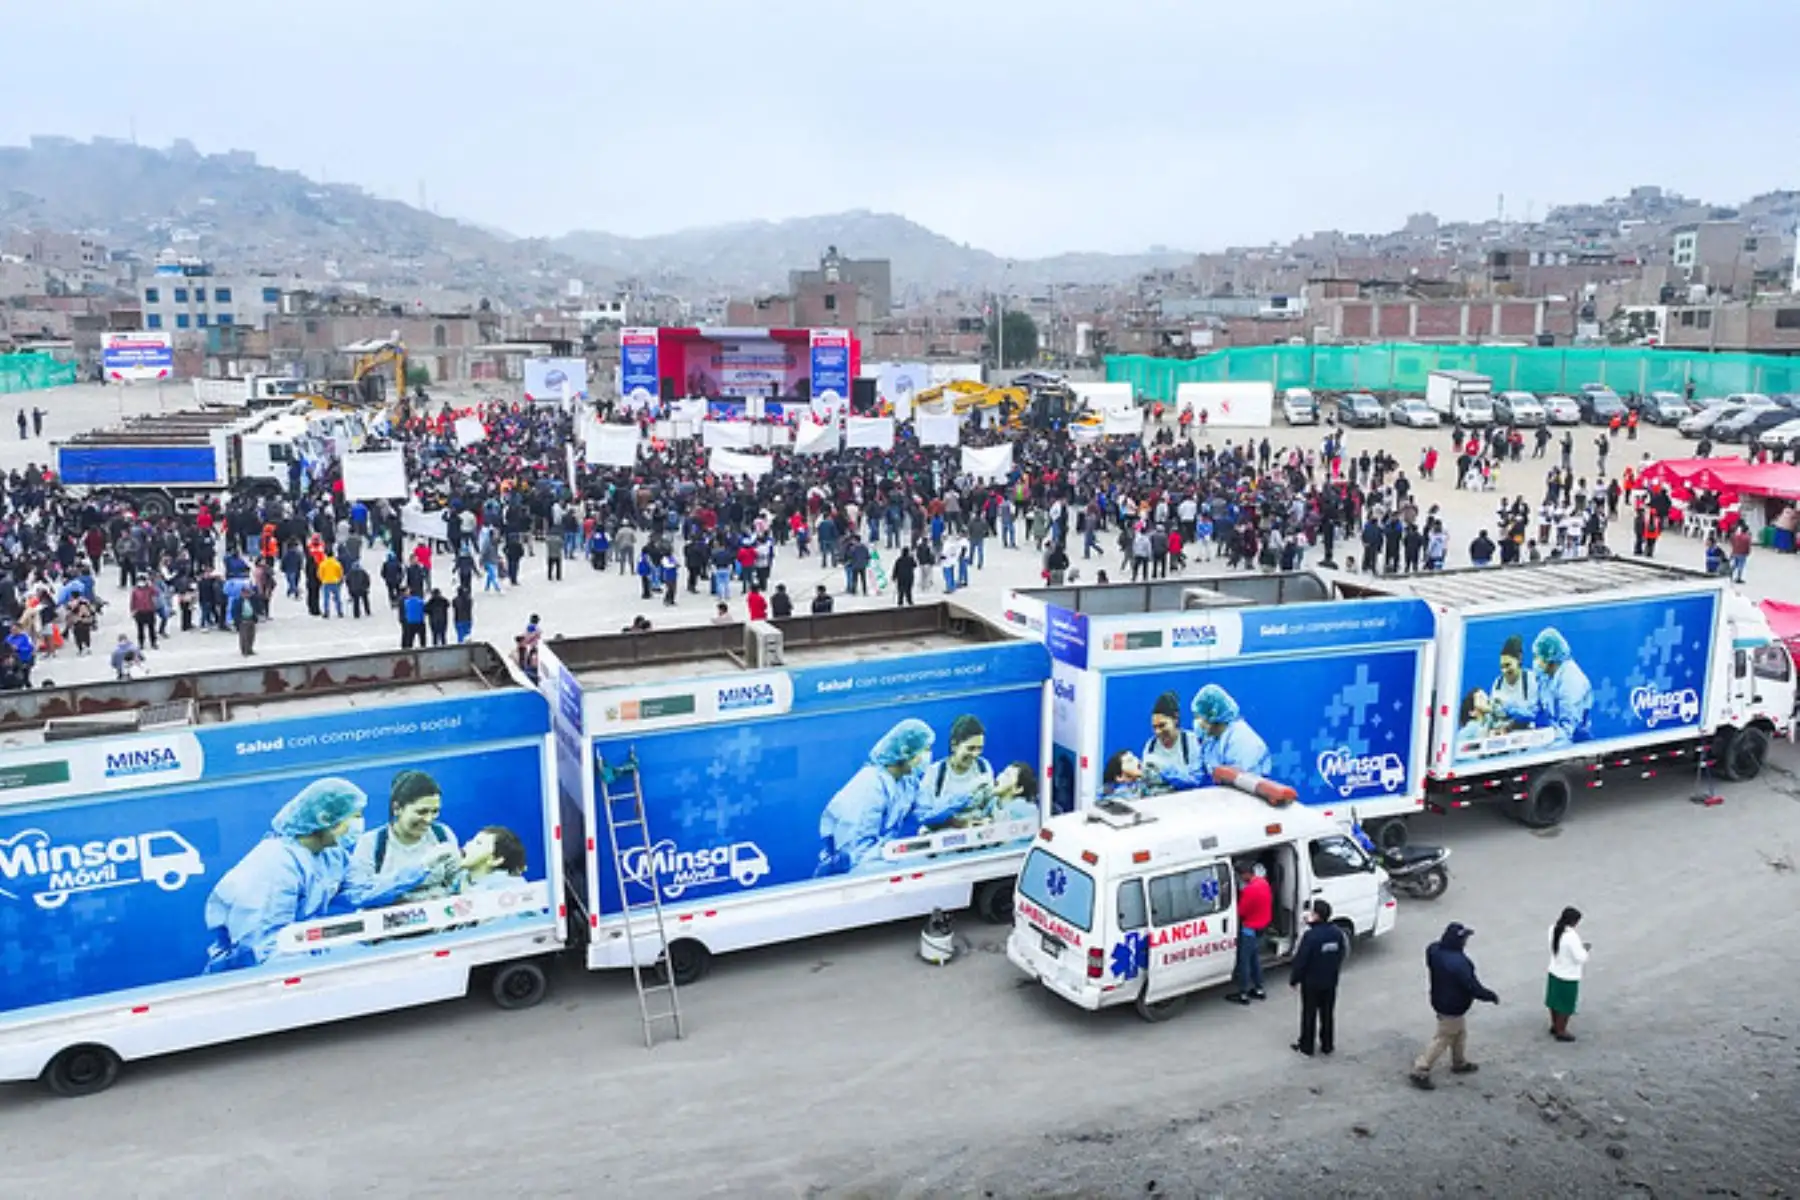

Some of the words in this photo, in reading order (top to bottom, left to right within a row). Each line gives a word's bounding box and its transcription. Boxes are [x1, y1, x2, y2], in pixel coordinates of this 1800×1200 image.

[718, 683, 774, 703] MINSA
[817, 678, 853, 693] Salud
[236, 737, 284, 756] Salud
[287, 734, 317, 748] con
[319, 721, 418, 745] compromiso
[420, 715, 462, 732] social
[106, 747, 177, 770] MINSA
[636, 846, 729, 878] Minsa
[50, 864, 118, 890] Móvil
[1018, 901, 1082, 947] AMBULANCIA
